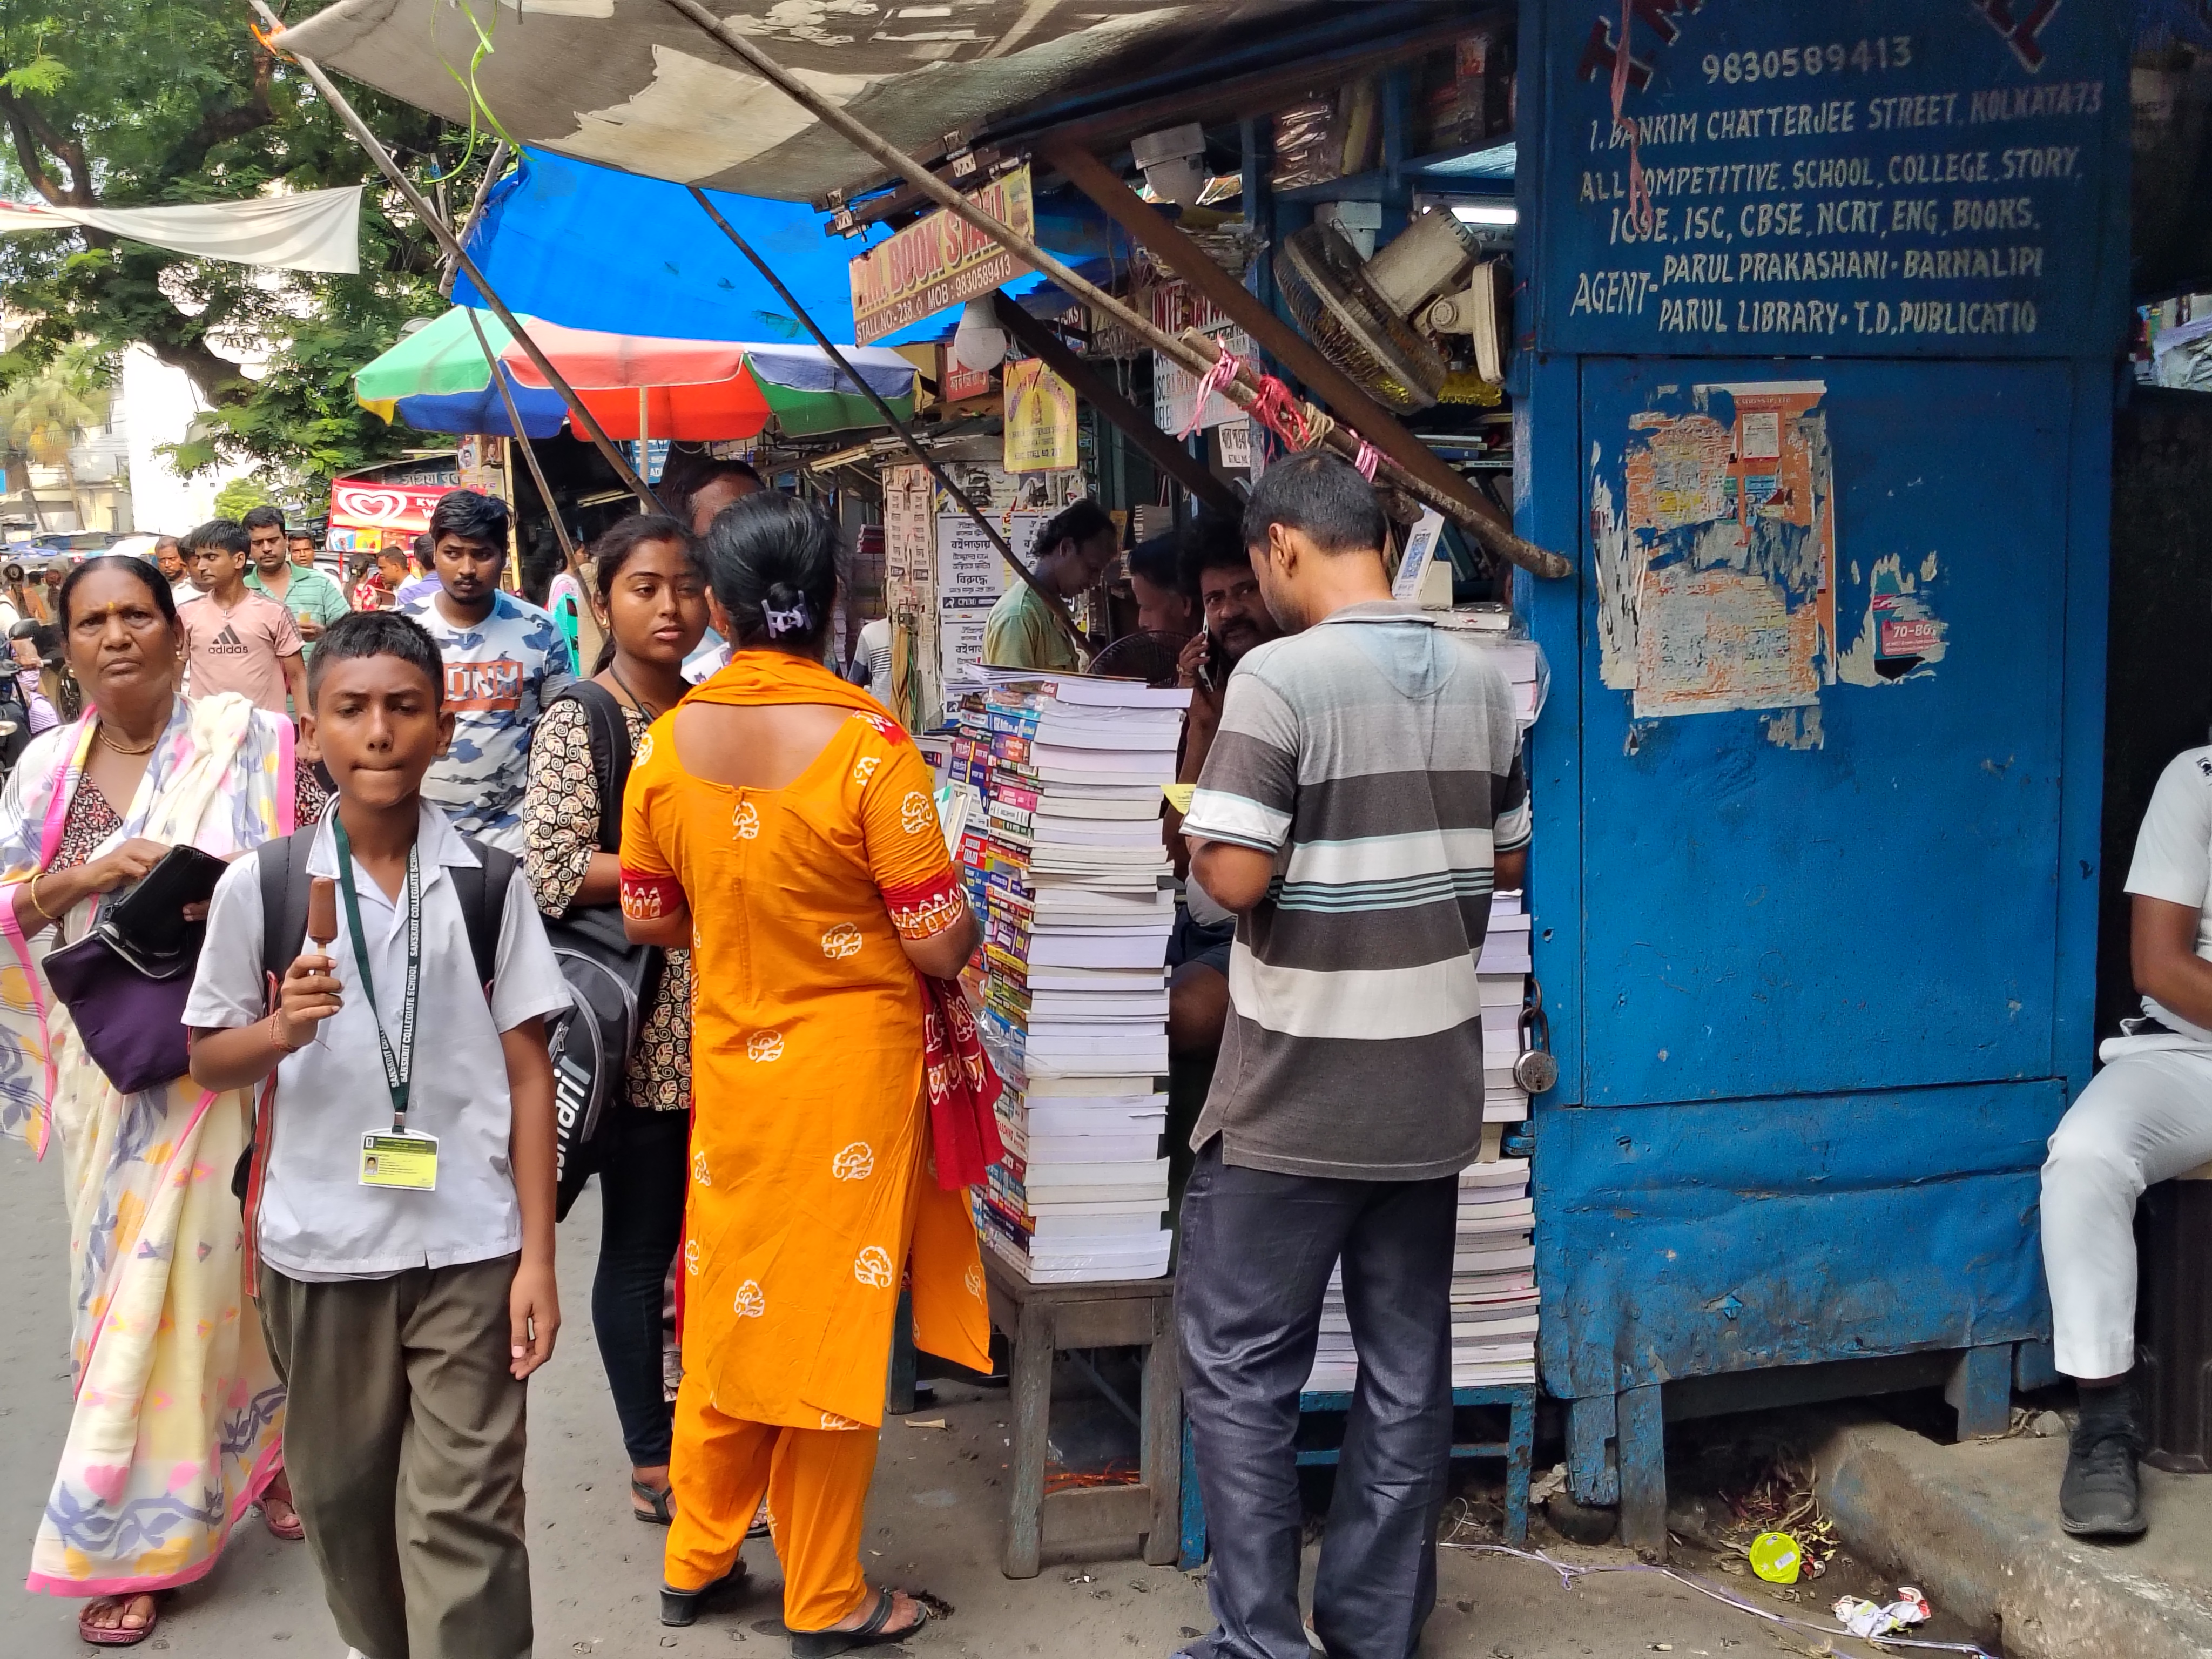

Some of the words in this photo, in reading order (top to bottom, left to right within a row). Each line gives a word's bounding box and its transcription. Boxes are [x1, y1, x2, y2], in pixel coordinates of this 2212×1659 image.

[1702, 35, 1911, 84] 9830589413
[1707, 101, 1856, 141] CHATTERJEE
[1580, 171, 1624, 202] ALL
[888, 218, 945, 295] BOOK
[1662, 253, 1734, 285] PARUL
[1739, 250, 1889, 283] PRAKASHANI
[1903, 246, 2044, 279] BARNALIPI
[857, 317, 878, 343] STALL
[927, 286, 949, 309] MOB
[955, 254, 1011, 298] 9830589413
[1658, 298, 1728, 333] PARUL
[1737, 299, 1840, 335] LIBRARY
[208, 645, 248, 654] adidas
